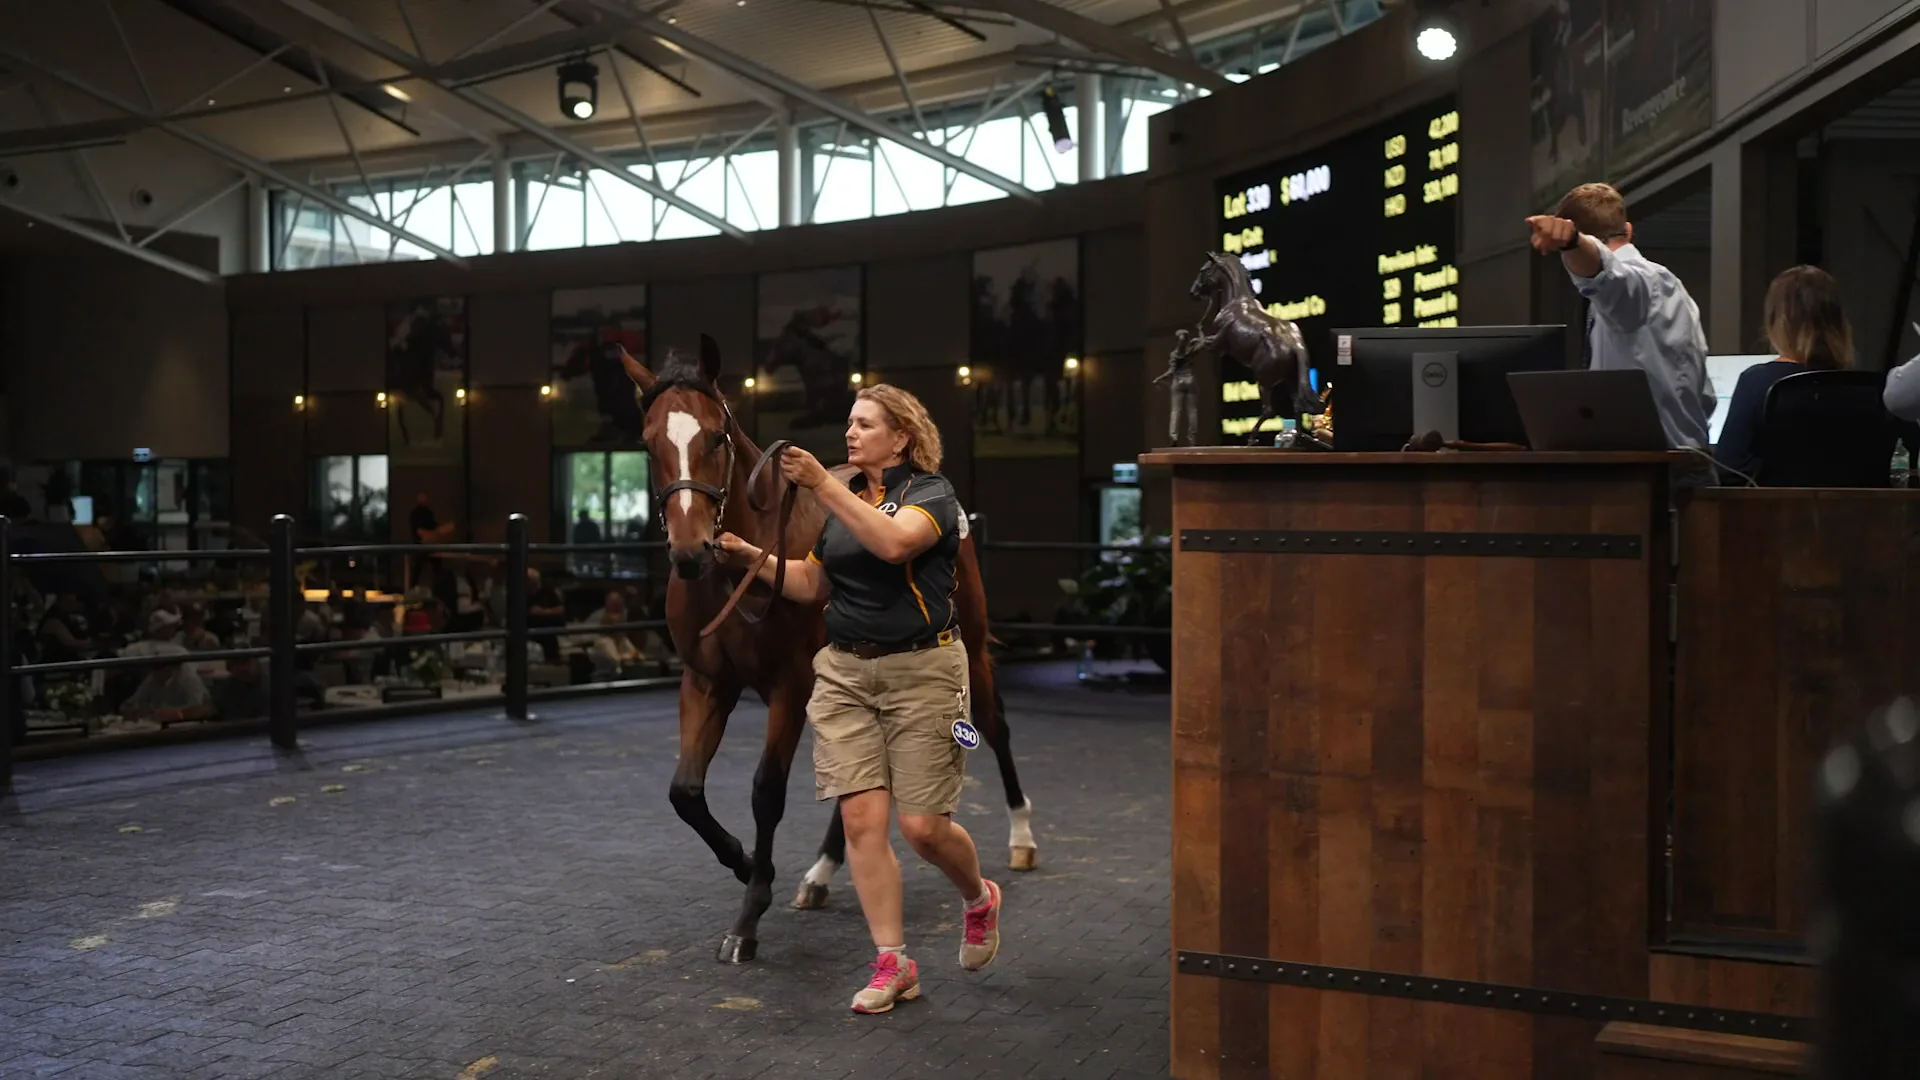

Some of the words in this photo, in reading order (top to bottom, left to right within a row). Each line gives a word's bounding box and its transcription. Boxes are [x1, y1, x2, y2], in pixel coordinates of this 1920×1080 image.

[1224, 192, 1246, 219] Lot
[1246, 184, 1271, 213] 330
[954, 724, 977, 745] 330
